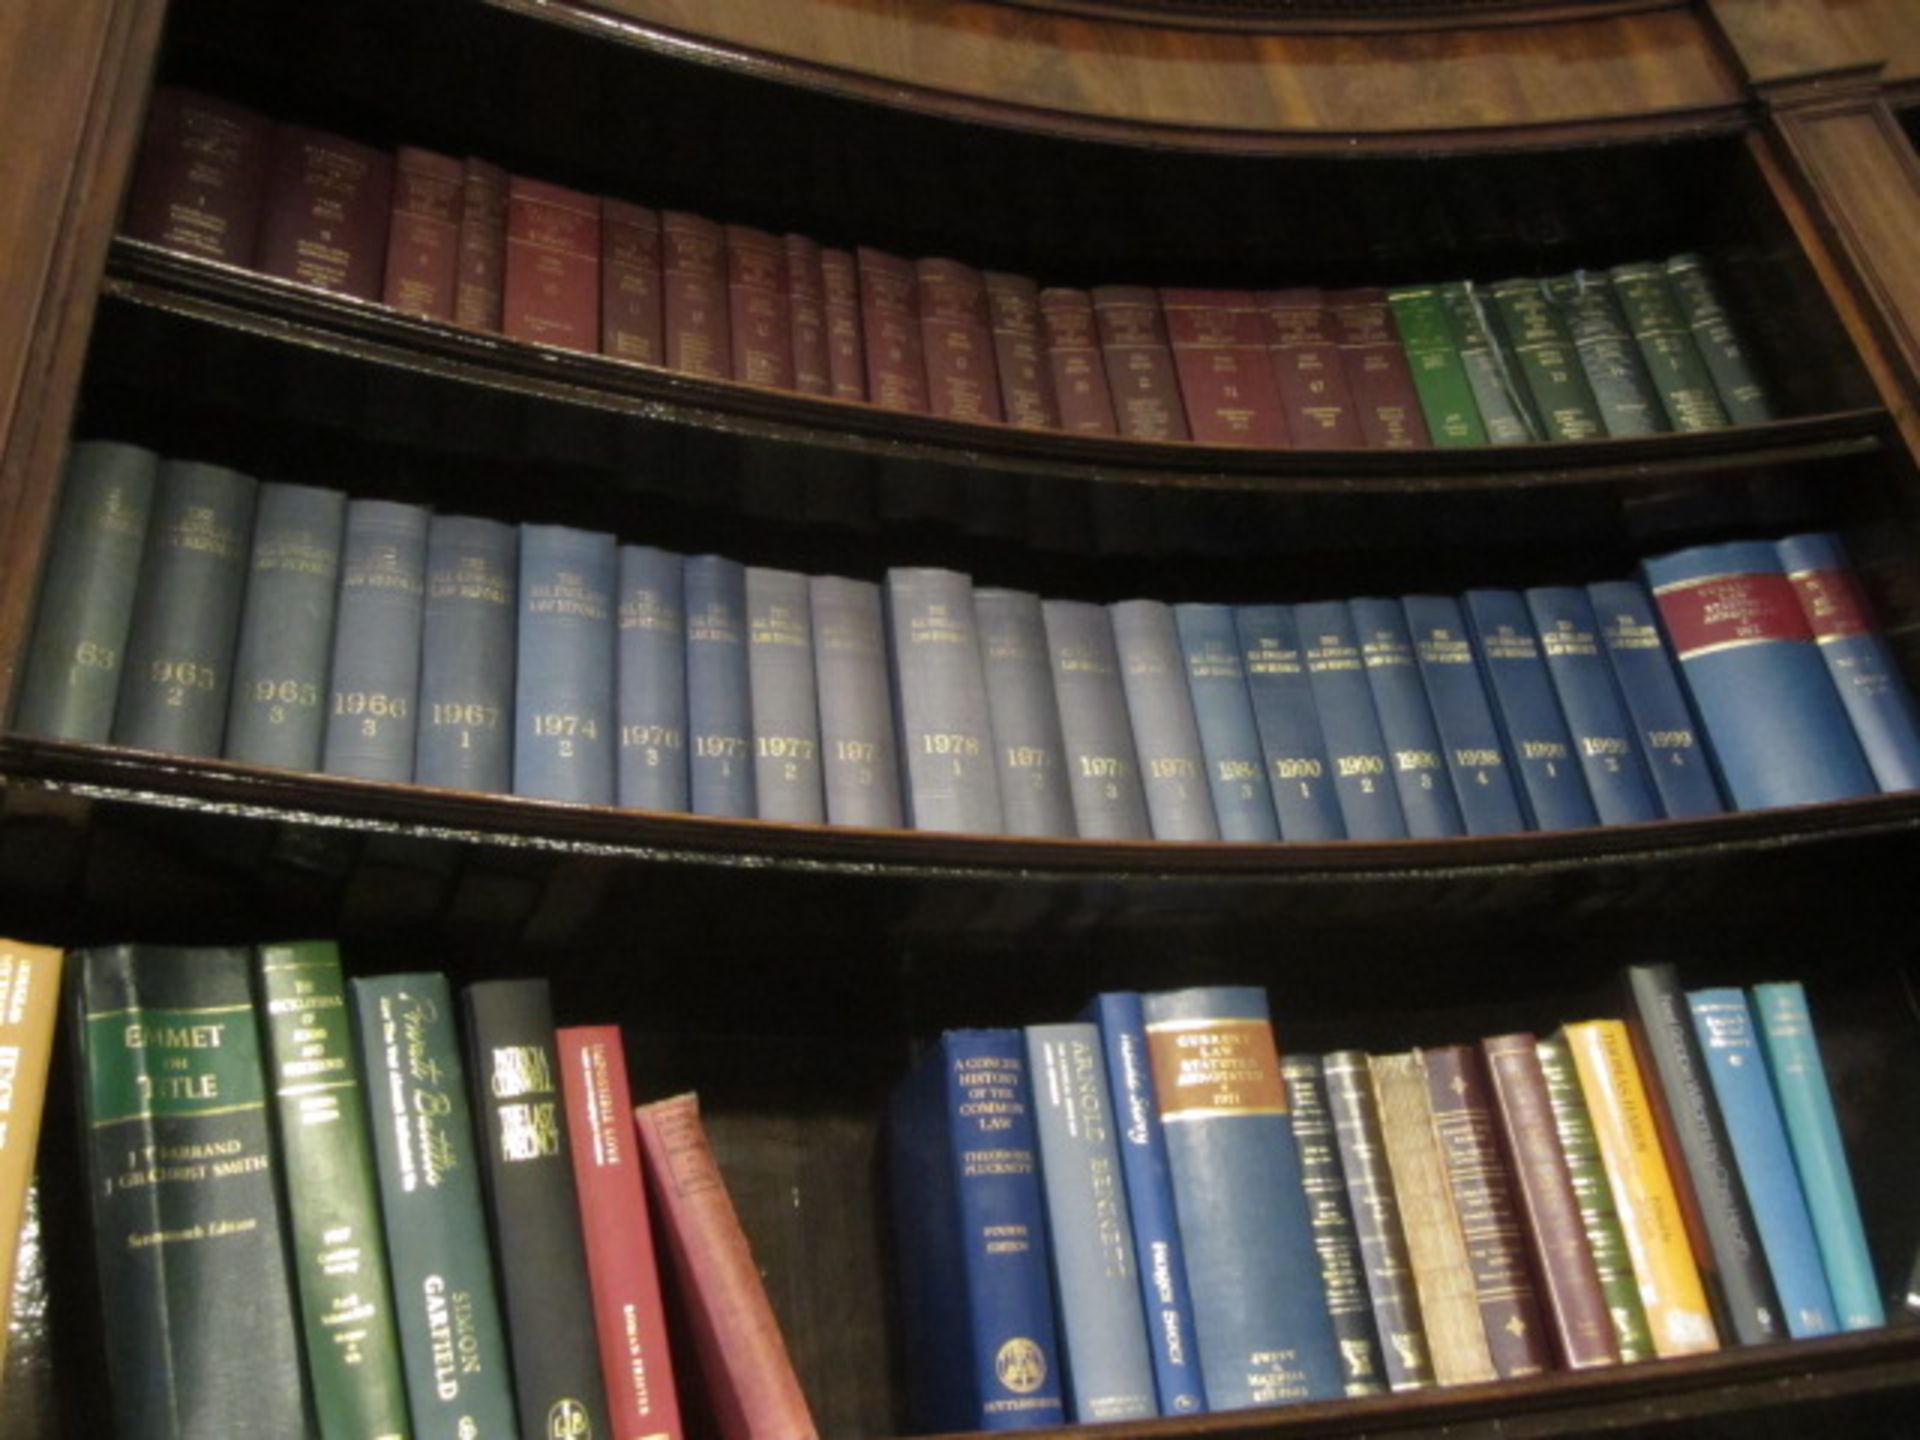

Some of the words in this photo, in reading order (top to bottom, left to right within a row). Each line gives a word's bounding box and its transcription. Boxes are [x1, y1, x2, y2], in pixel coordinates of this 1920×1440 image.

[361, 718, 377, 737] 3
[432, 702, 499, 729] 1967
[532, 713, 598, 741] 1974
[459, 730, 471, 749] 1
[558, 739, 575, 758] 2
[757, 736, 815, 761] 1977
[836, 740, 876, 762] 197
[645, 748, 659, 767] 3
[1007, 747, 1045, 768] 197
[784, 762, 798, 782] 2
[1360, 777, 1375, 794] 2
[124, 1023, 225, 1049] EMMET
[135, 1073, 219, 1099] TITLE
[1071, 1039, 1105, 1144] ARNOLD
[413, 1087, 458, 1188] Battles
[212, 1154, 269, 1178] SMITH
[424, 1273, 459, 1402] GARFIELD
[452, 1291, 481, 1374] SIMON
